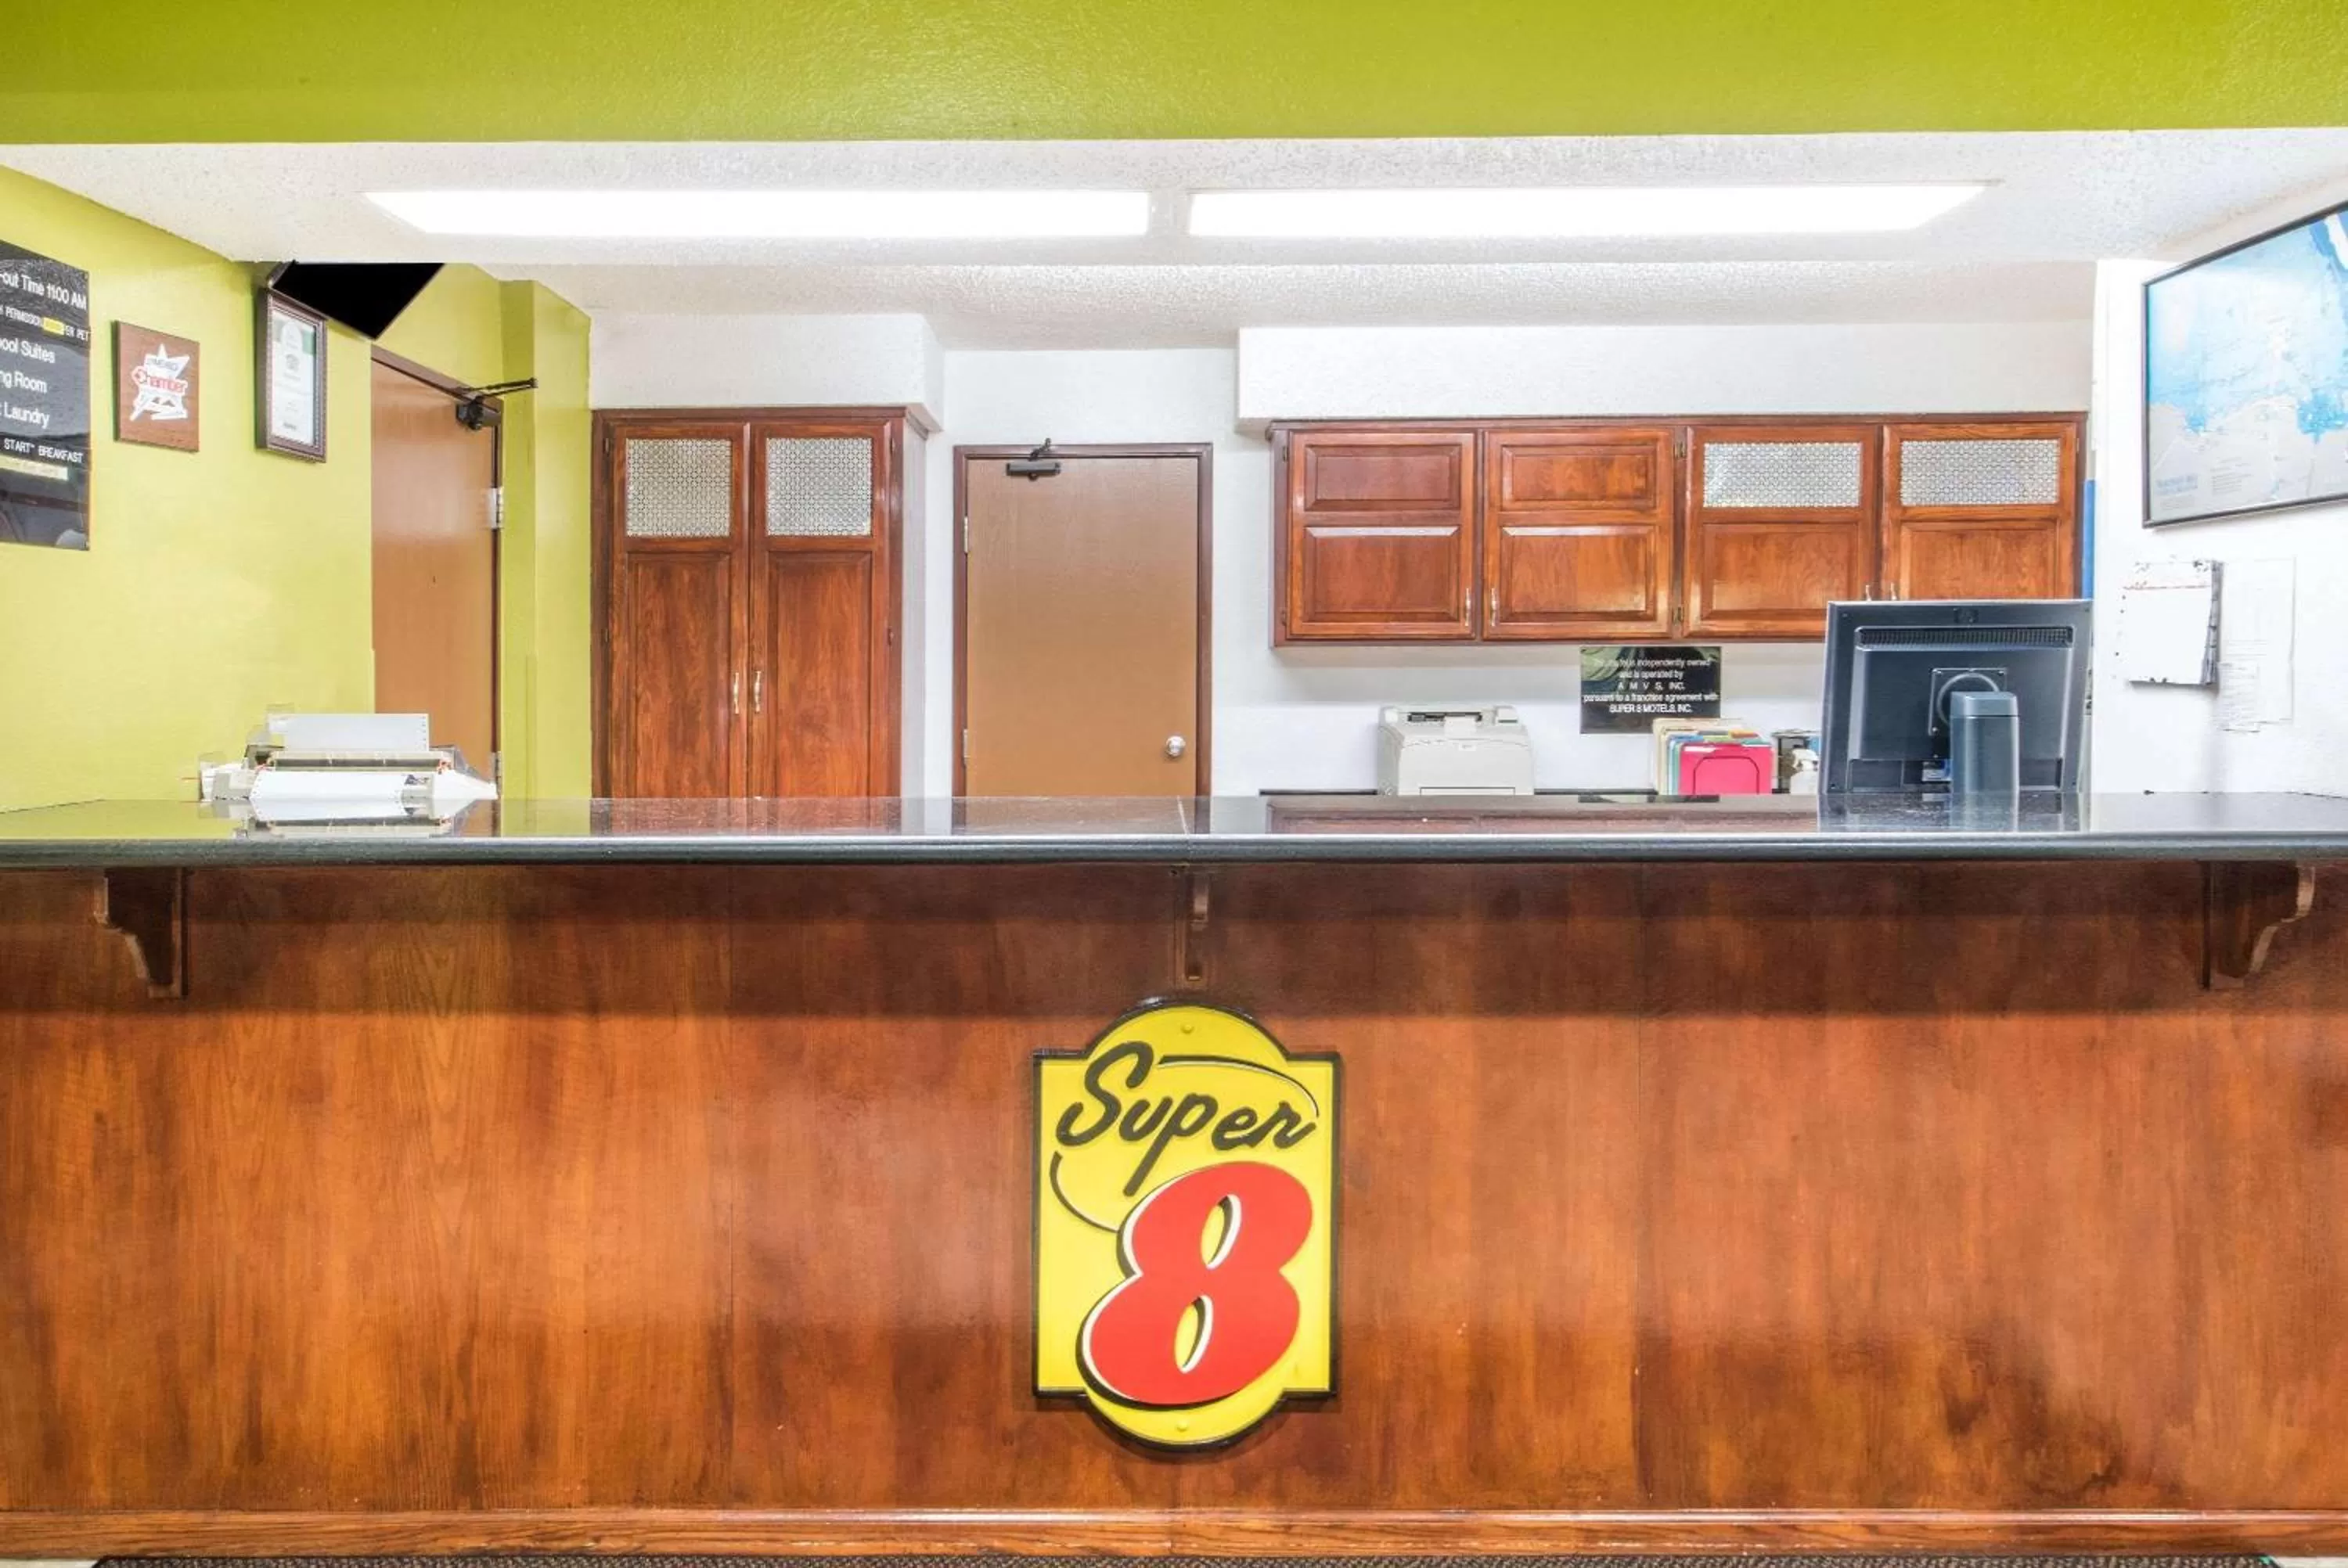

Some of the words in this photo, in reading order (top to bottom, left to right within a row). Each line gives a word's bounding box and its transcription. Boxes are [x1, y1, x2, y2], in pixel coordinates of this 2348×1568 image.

[21, 274, 45, 297] Time
[70, 292, 87, 311] AM
[20, 340, 56, 364] Suites
[14, 371, 48, 394] Room
[4, 401, 50, 429] Laundry
[38, 445, 84, 464] BREAKFAST
[1674, 669, 1684, 681] by
[1609, 703, 1635, 713] SUPER
[1665, 693, 1703, 703] agreement
[1055, 1041, 1317, 1198] Super
[1075, 1160, 1313, 1412] 8
